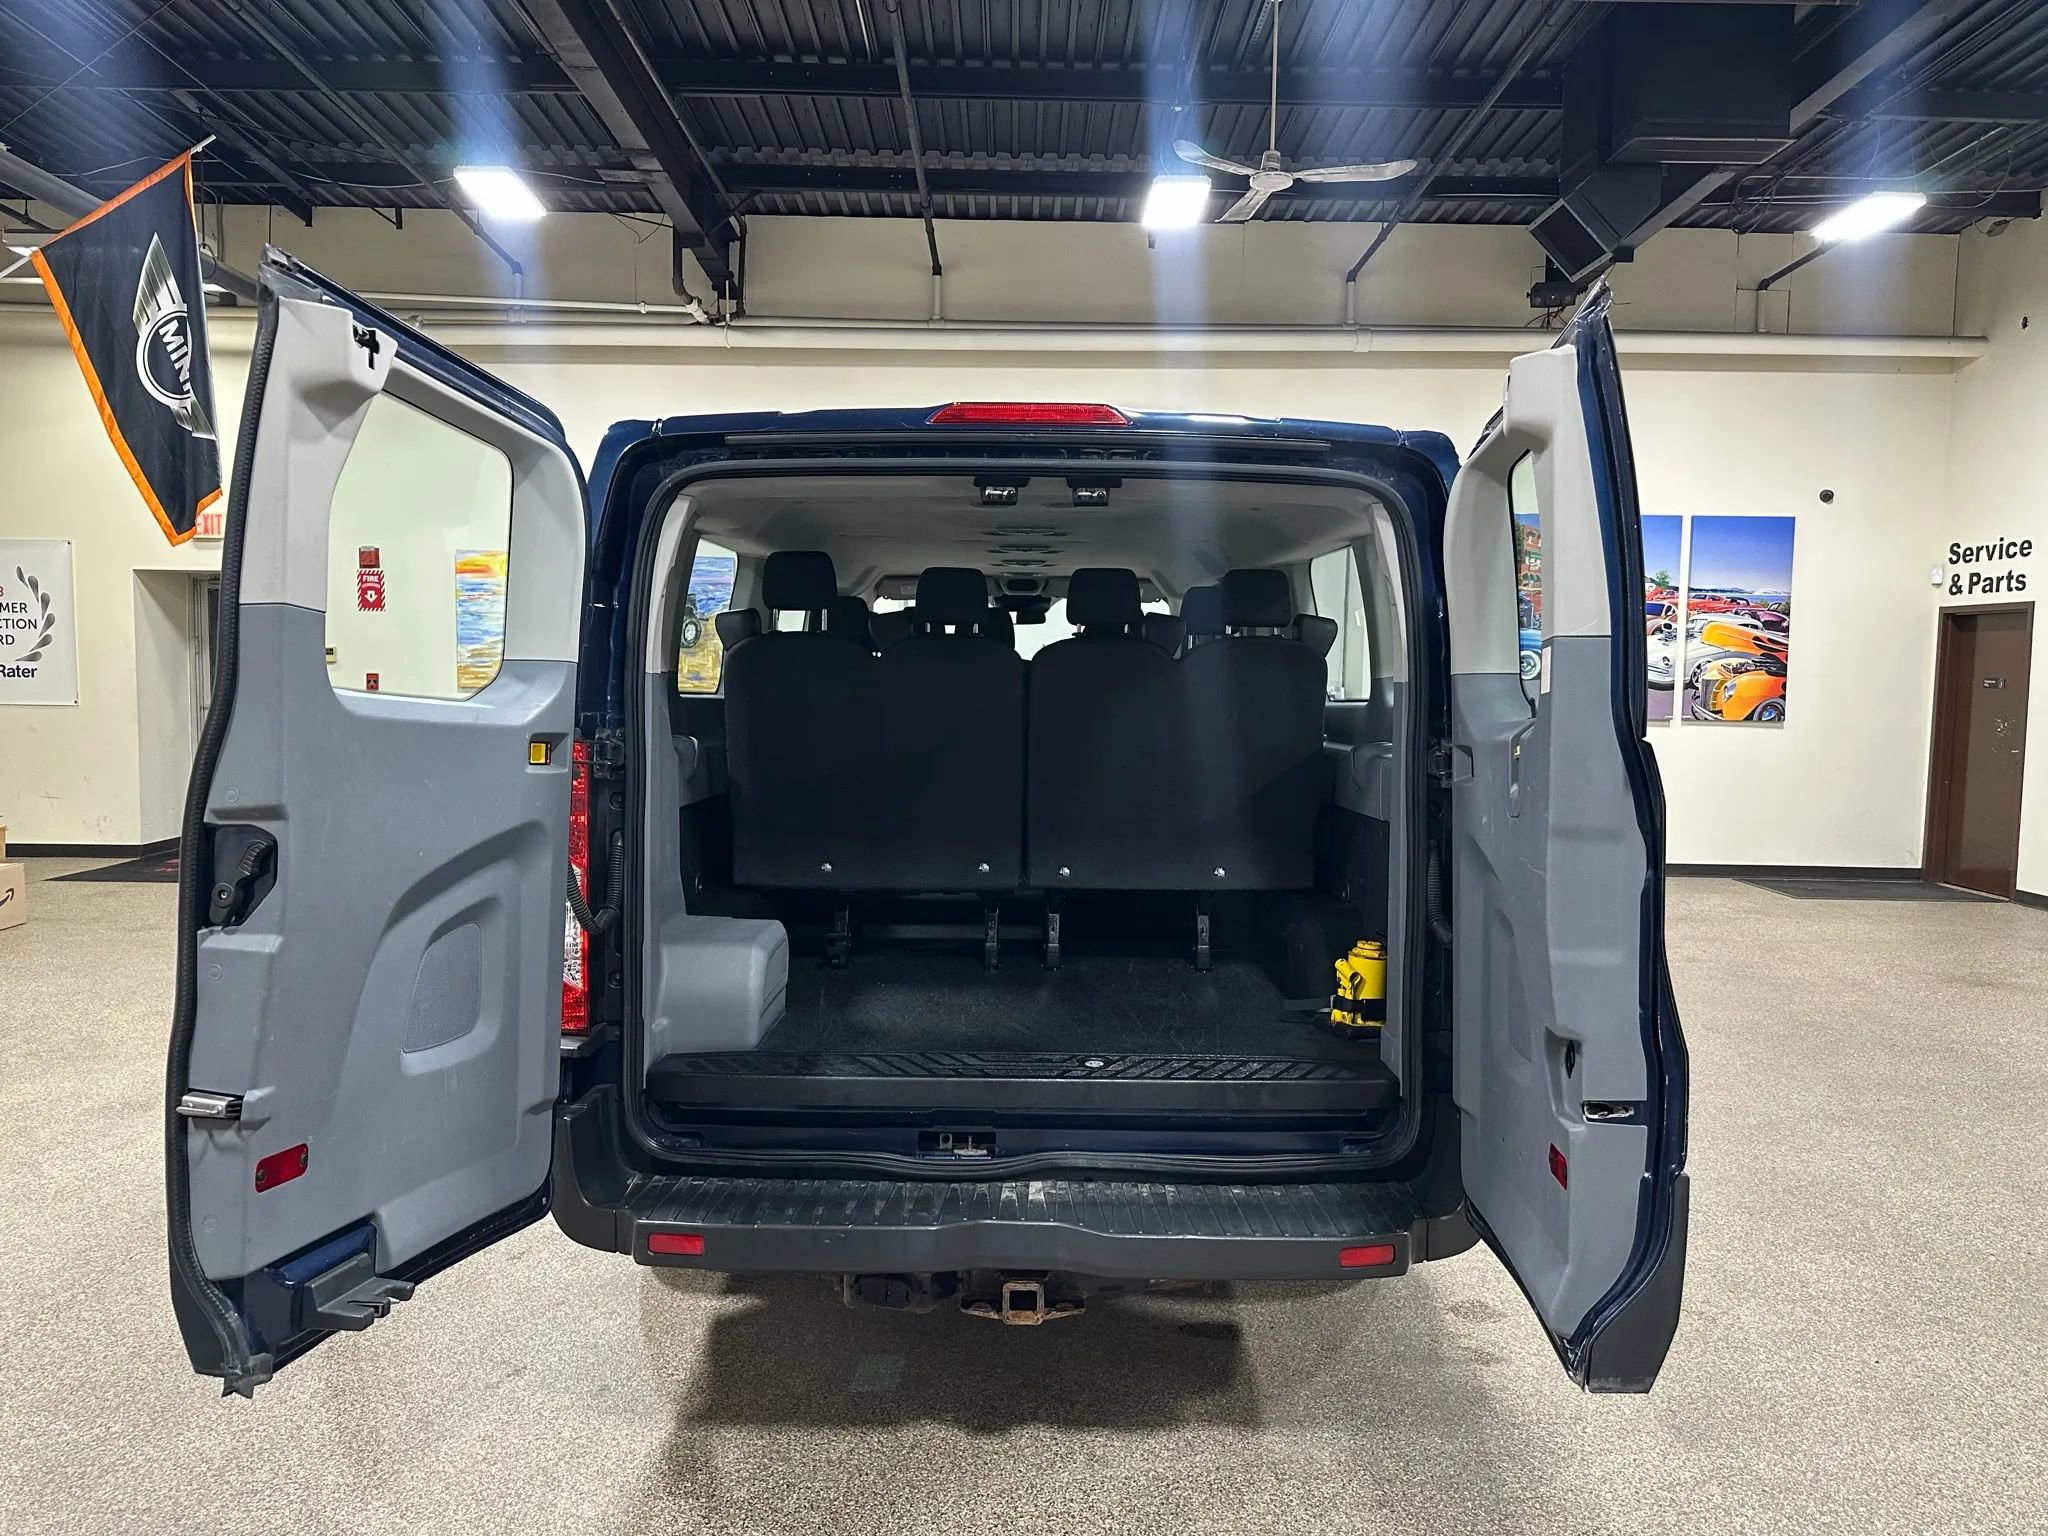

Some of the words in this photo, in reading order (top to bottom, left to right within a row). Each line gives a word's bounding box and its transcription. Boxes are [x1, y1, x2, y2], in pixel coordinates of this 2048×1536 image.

[1948, 537, 2033, 565] Service
[1948, 573, 1963, 596] &
[1968, 569, 2027, 595] Parts
[0, 618, 38, 630] TION
